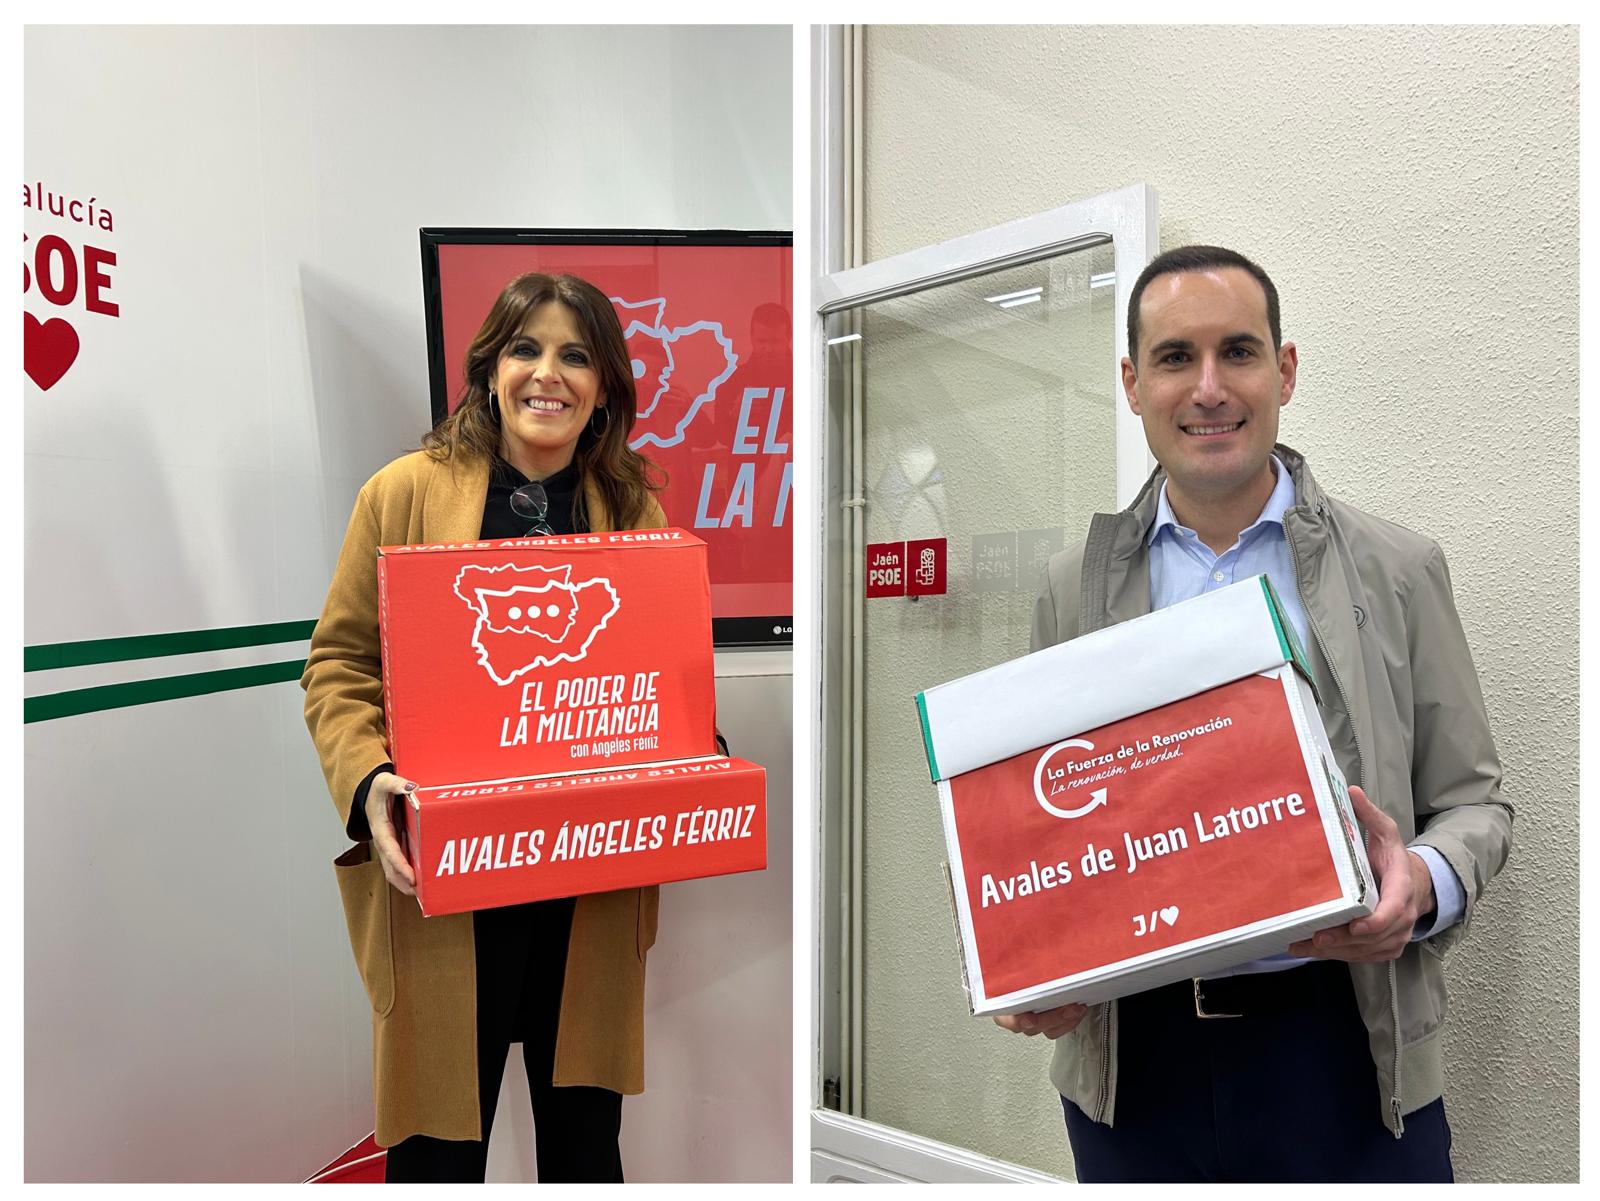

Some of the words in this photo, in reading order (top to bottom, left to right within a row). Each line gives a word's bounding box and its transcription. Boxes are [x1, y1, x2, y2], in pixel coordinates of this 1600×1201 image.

[24, 232, 119, 318] OE
[732, 387, 788, 454] EL
[694, 462, 755, 528] LA
[869, 567, 902, 586] PSOE
[872, 551, 898, 566] Jaén
[520, 681, 545, 713] EL
[554, 674, 626, 709] PODER
[631, 671, 660, 702] DE
[500, 715, 528, 747] LA
[536, 703, 659, 743] MILITANCIA
[570, 743, 589, 758] con
[592, 736, 631, 758] Ángeles
[1047, 767, 1065, 780] La
[1066, 750, 1114, 775] Fuerza
[1116, 744, 1134, 760] de
[1135, 740, 1151, 754] la
[1152, 715, 1232, 749] Renovación
[1050, 781, 1066, 796] La
[1067, 766, 1127, 790] renovación,
[1130, 757, 1144, 771] de
[1145, 744, 1184, 766] verdad.
[436, 829, 546, 877] AVALES
[550, 814, 667, 863] ÁNGELES
[672, 804, 756, 847] FÉRRIZ
[981, 860, 1073, 909] Avales
[1080, 843, 1116, 878] de
[1123, 825, 1189, 874] Juan
[1193, 792, 1306, 843] Latorre
